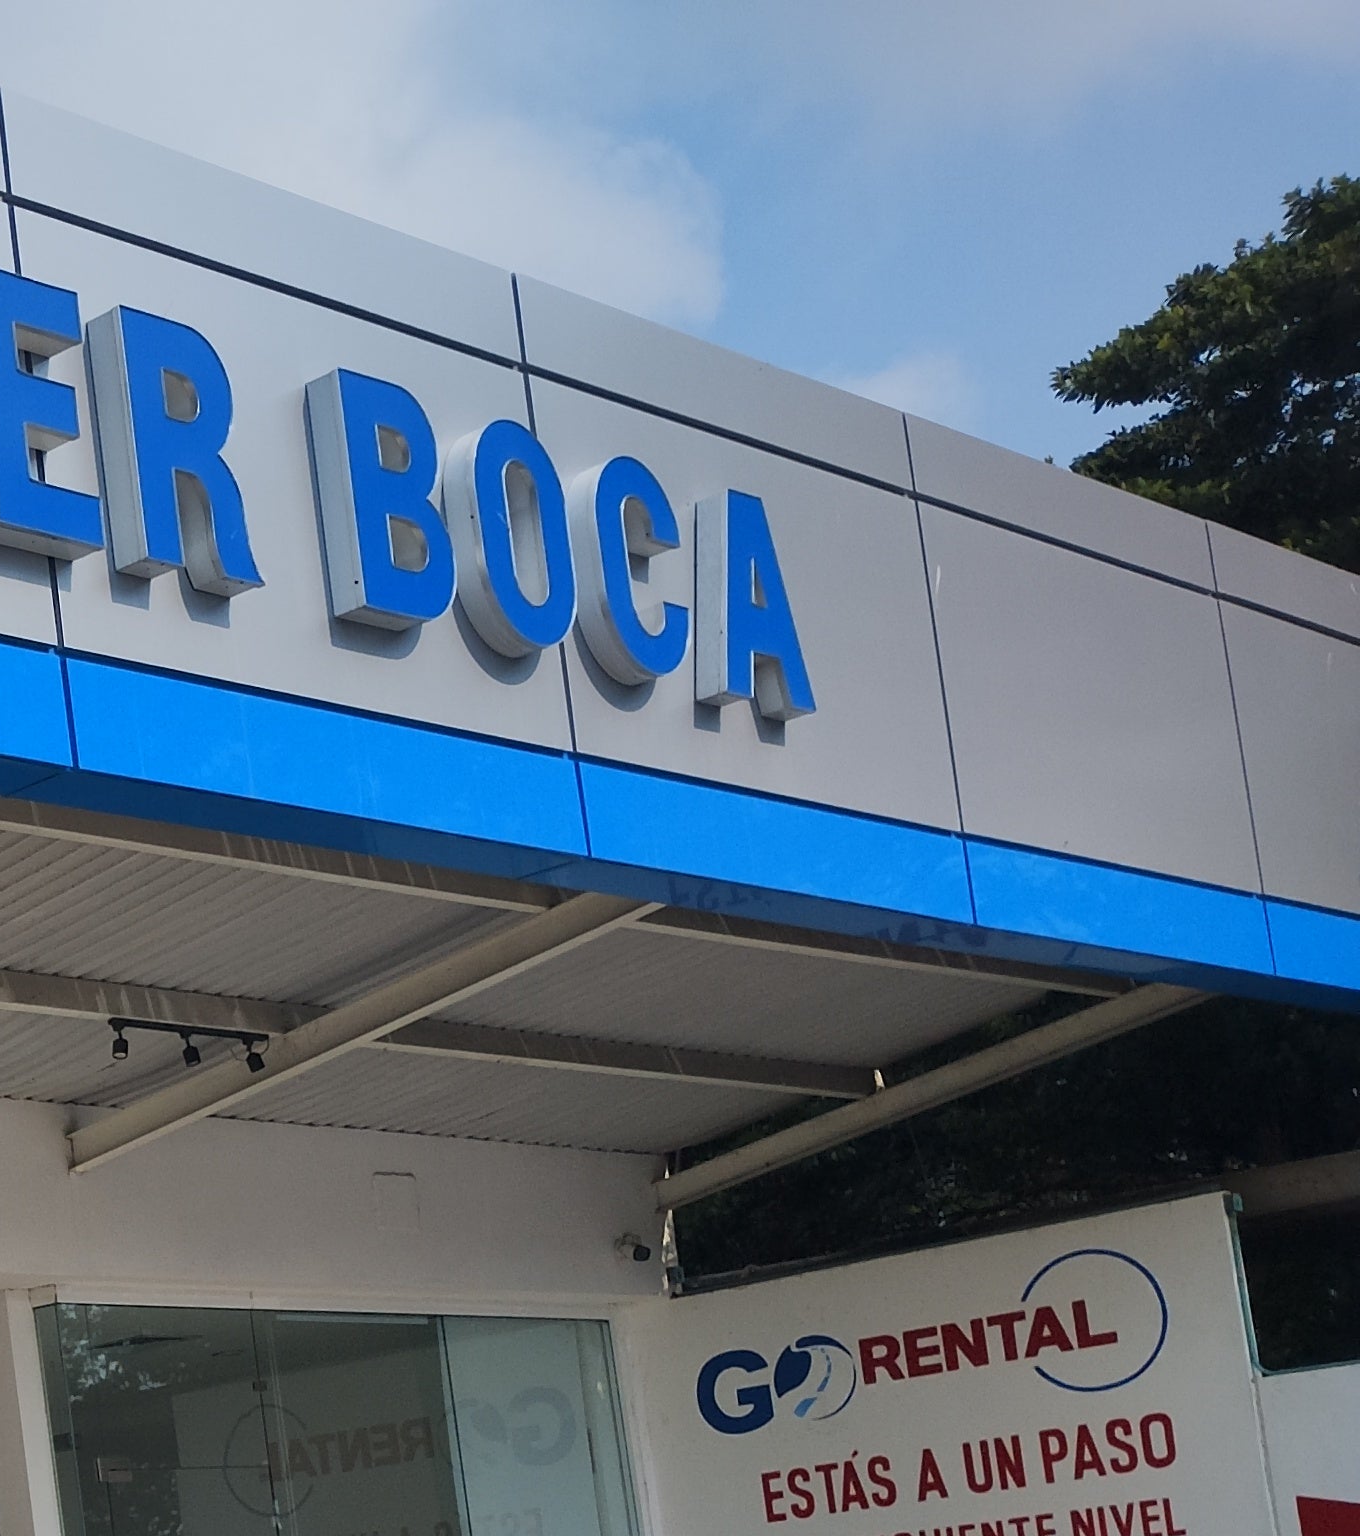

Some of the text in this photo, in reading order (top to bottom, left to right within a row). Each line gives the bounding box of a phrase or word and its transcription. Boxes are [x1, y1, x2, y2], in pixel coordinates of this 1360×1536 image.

[305, 366, 818, 721] BOCA
[858, 1299, 1118, 1386] RENTAL
[760, 1412, 1177, 1524] ESTÁS A UN PASO
